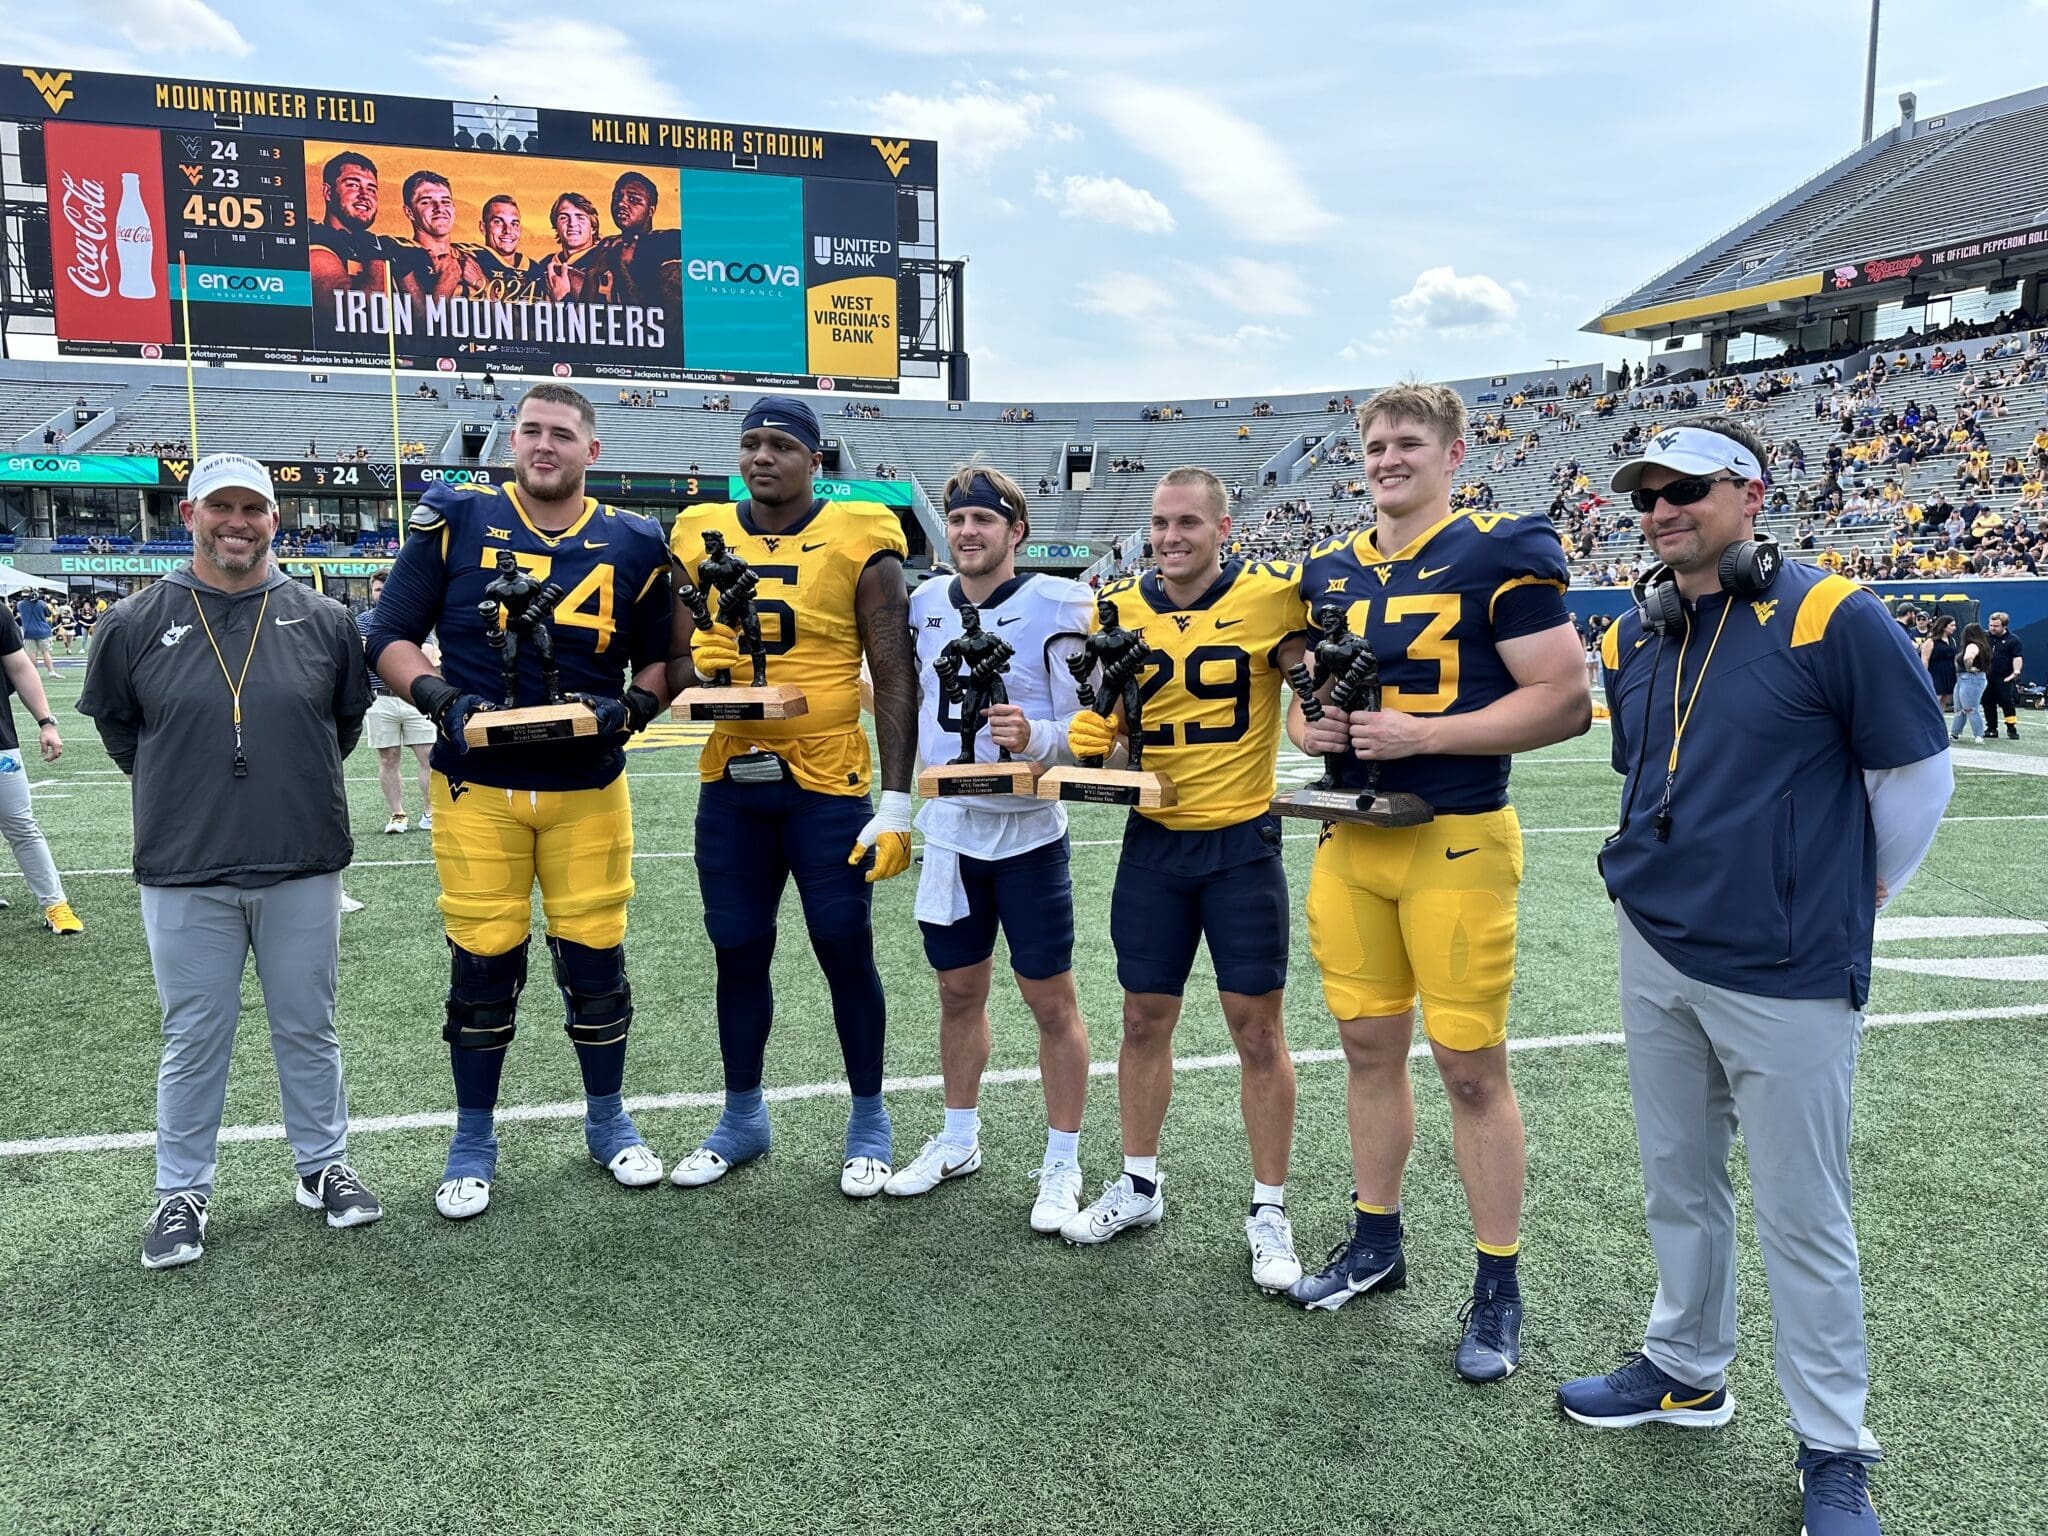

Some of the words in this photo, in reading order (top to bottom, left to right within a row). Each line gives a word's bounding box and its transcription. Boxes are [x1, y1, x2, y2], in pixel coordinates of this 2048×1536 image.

[155, 83, 307, 119] MOUNTAINEER
[316, 96, 375, 124] FIELD
[591, 118, 650, 146] MILAN
[659, 124, 734, 153] PUSKAR
[743, 131, 824, 160] STADIUM
[211, 140, 239, 160] 24
[272, 148, 281, 159] 3
[212, 168, 240, 188] 23
[274, 176, 282, 187] 3
[183, 194, 265, 229] 4:05
[284, 210, 296, 227] 3
[60, 168, 111, 298] Coca-Cola
[833, 237, 891, 254] UNITED
[1931, 252, 1946, 265] THE
[1946, 245, 1982, 261] OFFICIAL
[1983, 234, 2027, 255] PEPPERONI
[833, 253, 876, 268] BANK
[687, 258, 800, 287] encova
[198, 273, 284, 293] encova
[211, 292, 272, 300] INSURANCE
[468, 278, 543, 306] 2024
[704, 286, 783, 298] INSURANCE
[831, 295, 873, 311] WEST
[332, 288, 413, 336] IRON
[425, 293, 666, 348] MOUNTAINEERS
[814, 310, 891, 329] VIRGINIA'S
[832, 329, 874, 344] BANK
[301, 355, 332, 364] Jackpots
[486, 363, 501, 372] Play
[502, 363, 524, 372] Today!
[633, 370, 662, 379] Jackpots
[682, 373, 717, 381] MILLIONS!
[755, 376, 800, 386] wvlottery.com
[9, 458, 81, 472] encova
[203, 458, 224, 472] WEST
[317, 474, 325, 484] 3
[333, 467, 359, 485] 24
[421, 469, 490, 484] encova
[687, 478, 698, 495] 3
[813, 483, 851, 496] cova
[1026, 545, 1090, 558] encova
[480, 546, 617, 654] 74
[1138, 645, 1251, 747] 29
